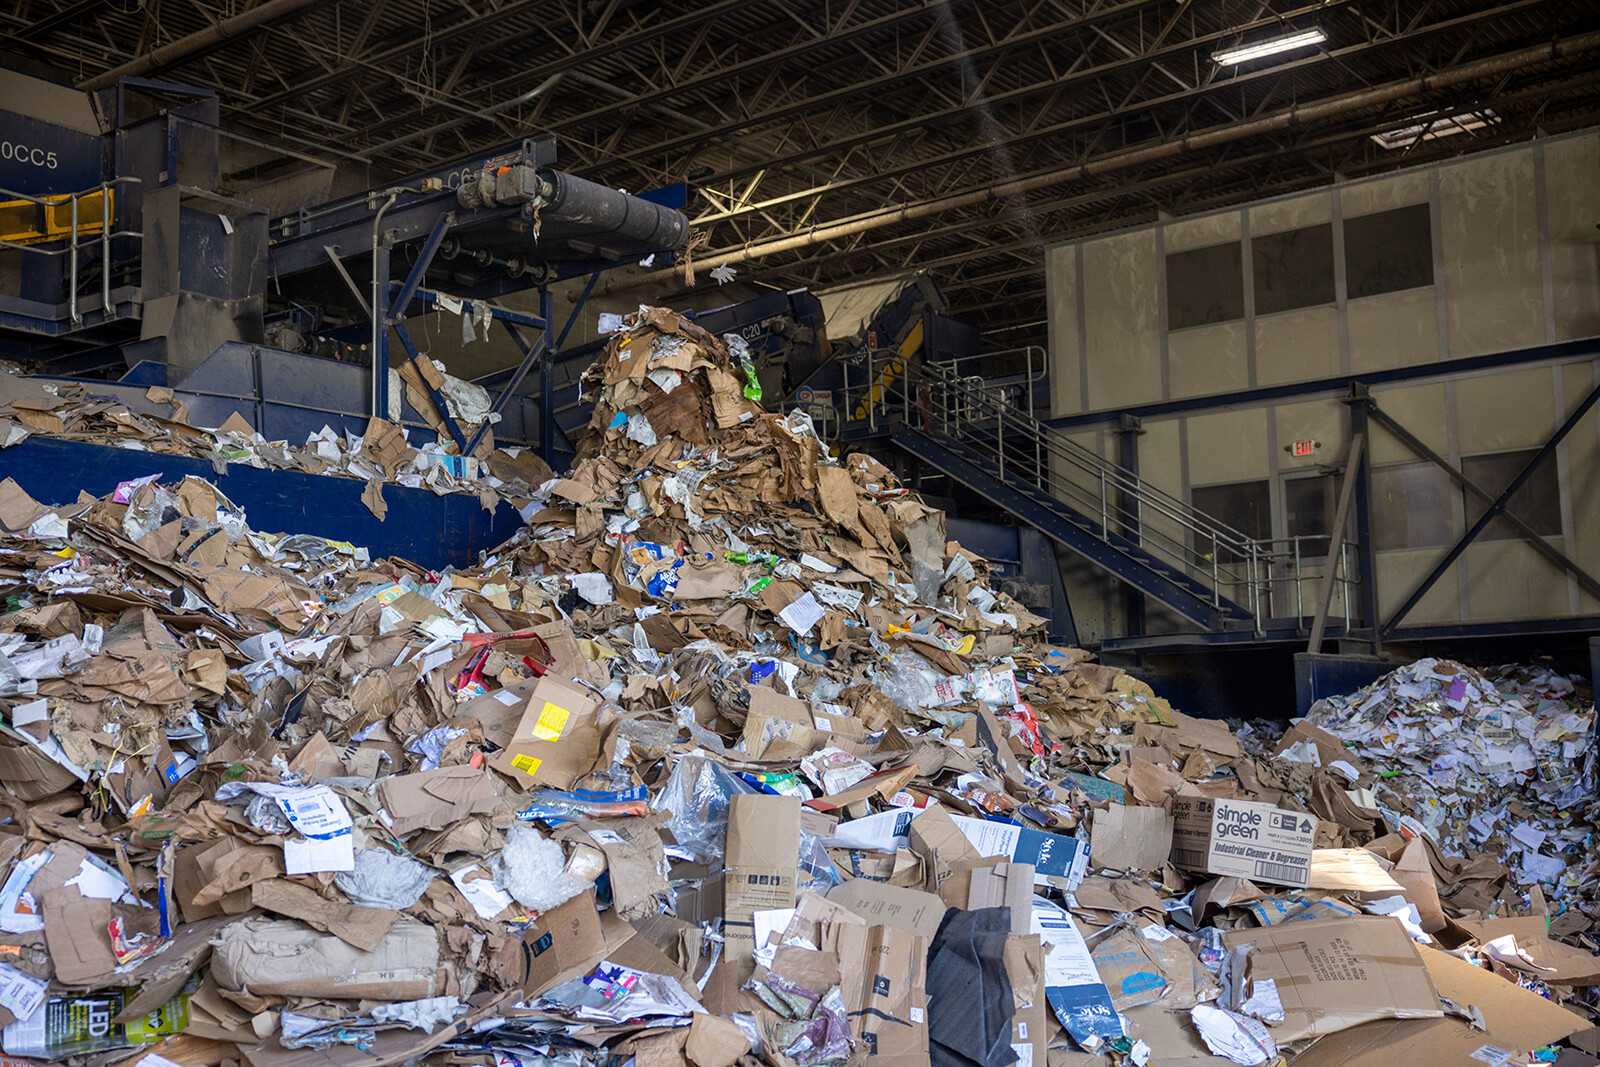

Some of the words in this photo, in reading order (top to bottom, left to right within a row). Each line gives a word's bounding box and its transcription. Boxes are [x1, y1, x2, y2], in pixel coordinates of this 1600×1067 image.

[1, 141, 58, 169] 0CC5
[742, 323, 760, 340] C20
[1296, 440, 1312, 455] EXIT
[1217, 804, 1262, 826] simple
[1273, 817, 1280, 825] 6
[1216, 822, 1259, 840] green
[1040, 837, 1055, 864] Style
[1214, 842, 1244, 856] Industrial
[1245, 847, 1270, 860] Cleaner
[1270, 852, 1276, 860] &
[1275, 852, 1308, 866] Degreaser
[88, 1000, 110, 1036] LED
[1080, 1004, 1111, 1017] Style
